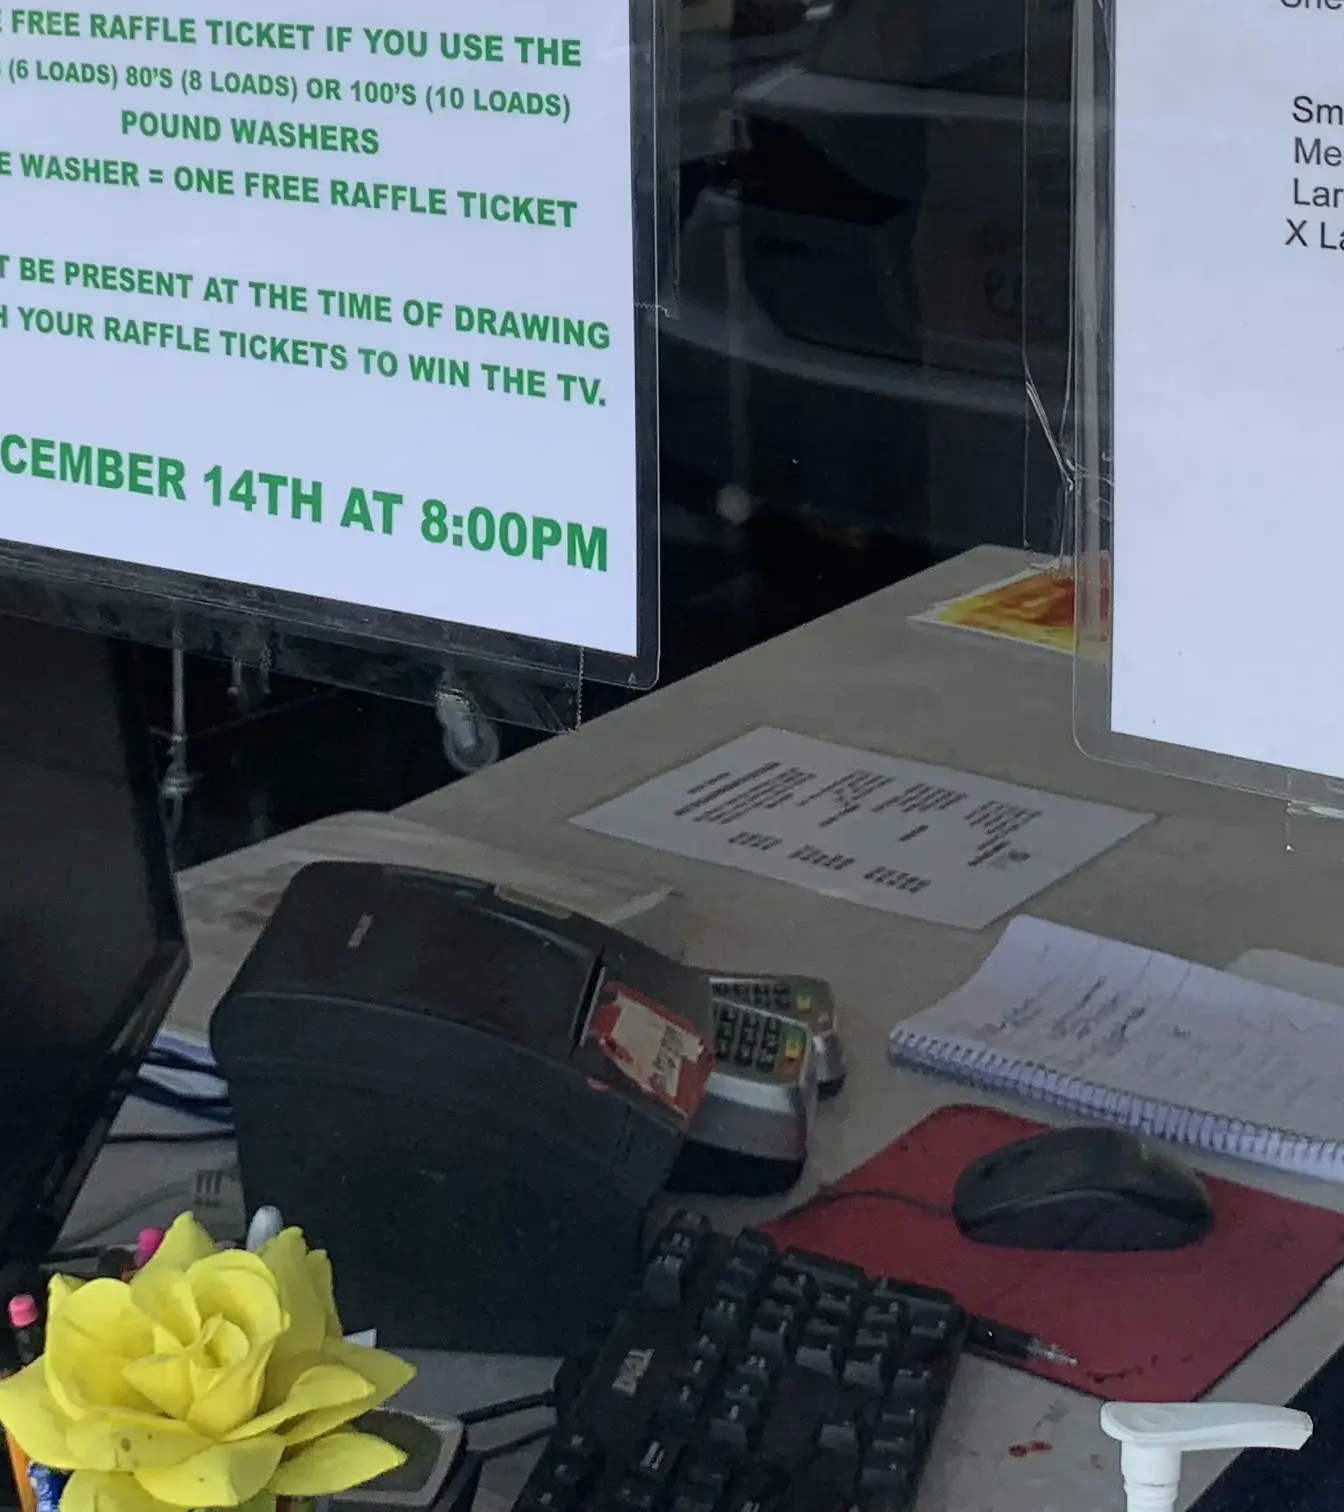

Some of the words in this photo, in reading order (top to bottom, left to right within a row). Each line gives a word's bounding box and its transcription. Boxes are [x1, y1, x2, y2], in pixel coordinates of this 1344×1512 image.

[11, 8, 81, 37] FREE
[89, 12, 197, 45] RAFFLE
[204, 18, 315, 51] TICKET
[325, 25, 353, 53] IF
[362, 27, 428, 58] YOU
[439, 31, 505, 63] USE
[513, 35, 582, 68] THE
[1284, 218, 1309, 248] X
[19, 256, 56, 285] BE
[64, 260, 194, 300] PRESENT
[202, 276, 240, 305] AT
[247, 280, 308, 313] THE
[316, 288, 393, 324] TIME
[402, 299, 444, 329] OF
[454, 304, 611, 351] DRAWING
[203, 464, 323, 524] 14TH
[339, 486, 404, 536] AT
[420, 498, 608, 573] 8:00PM
